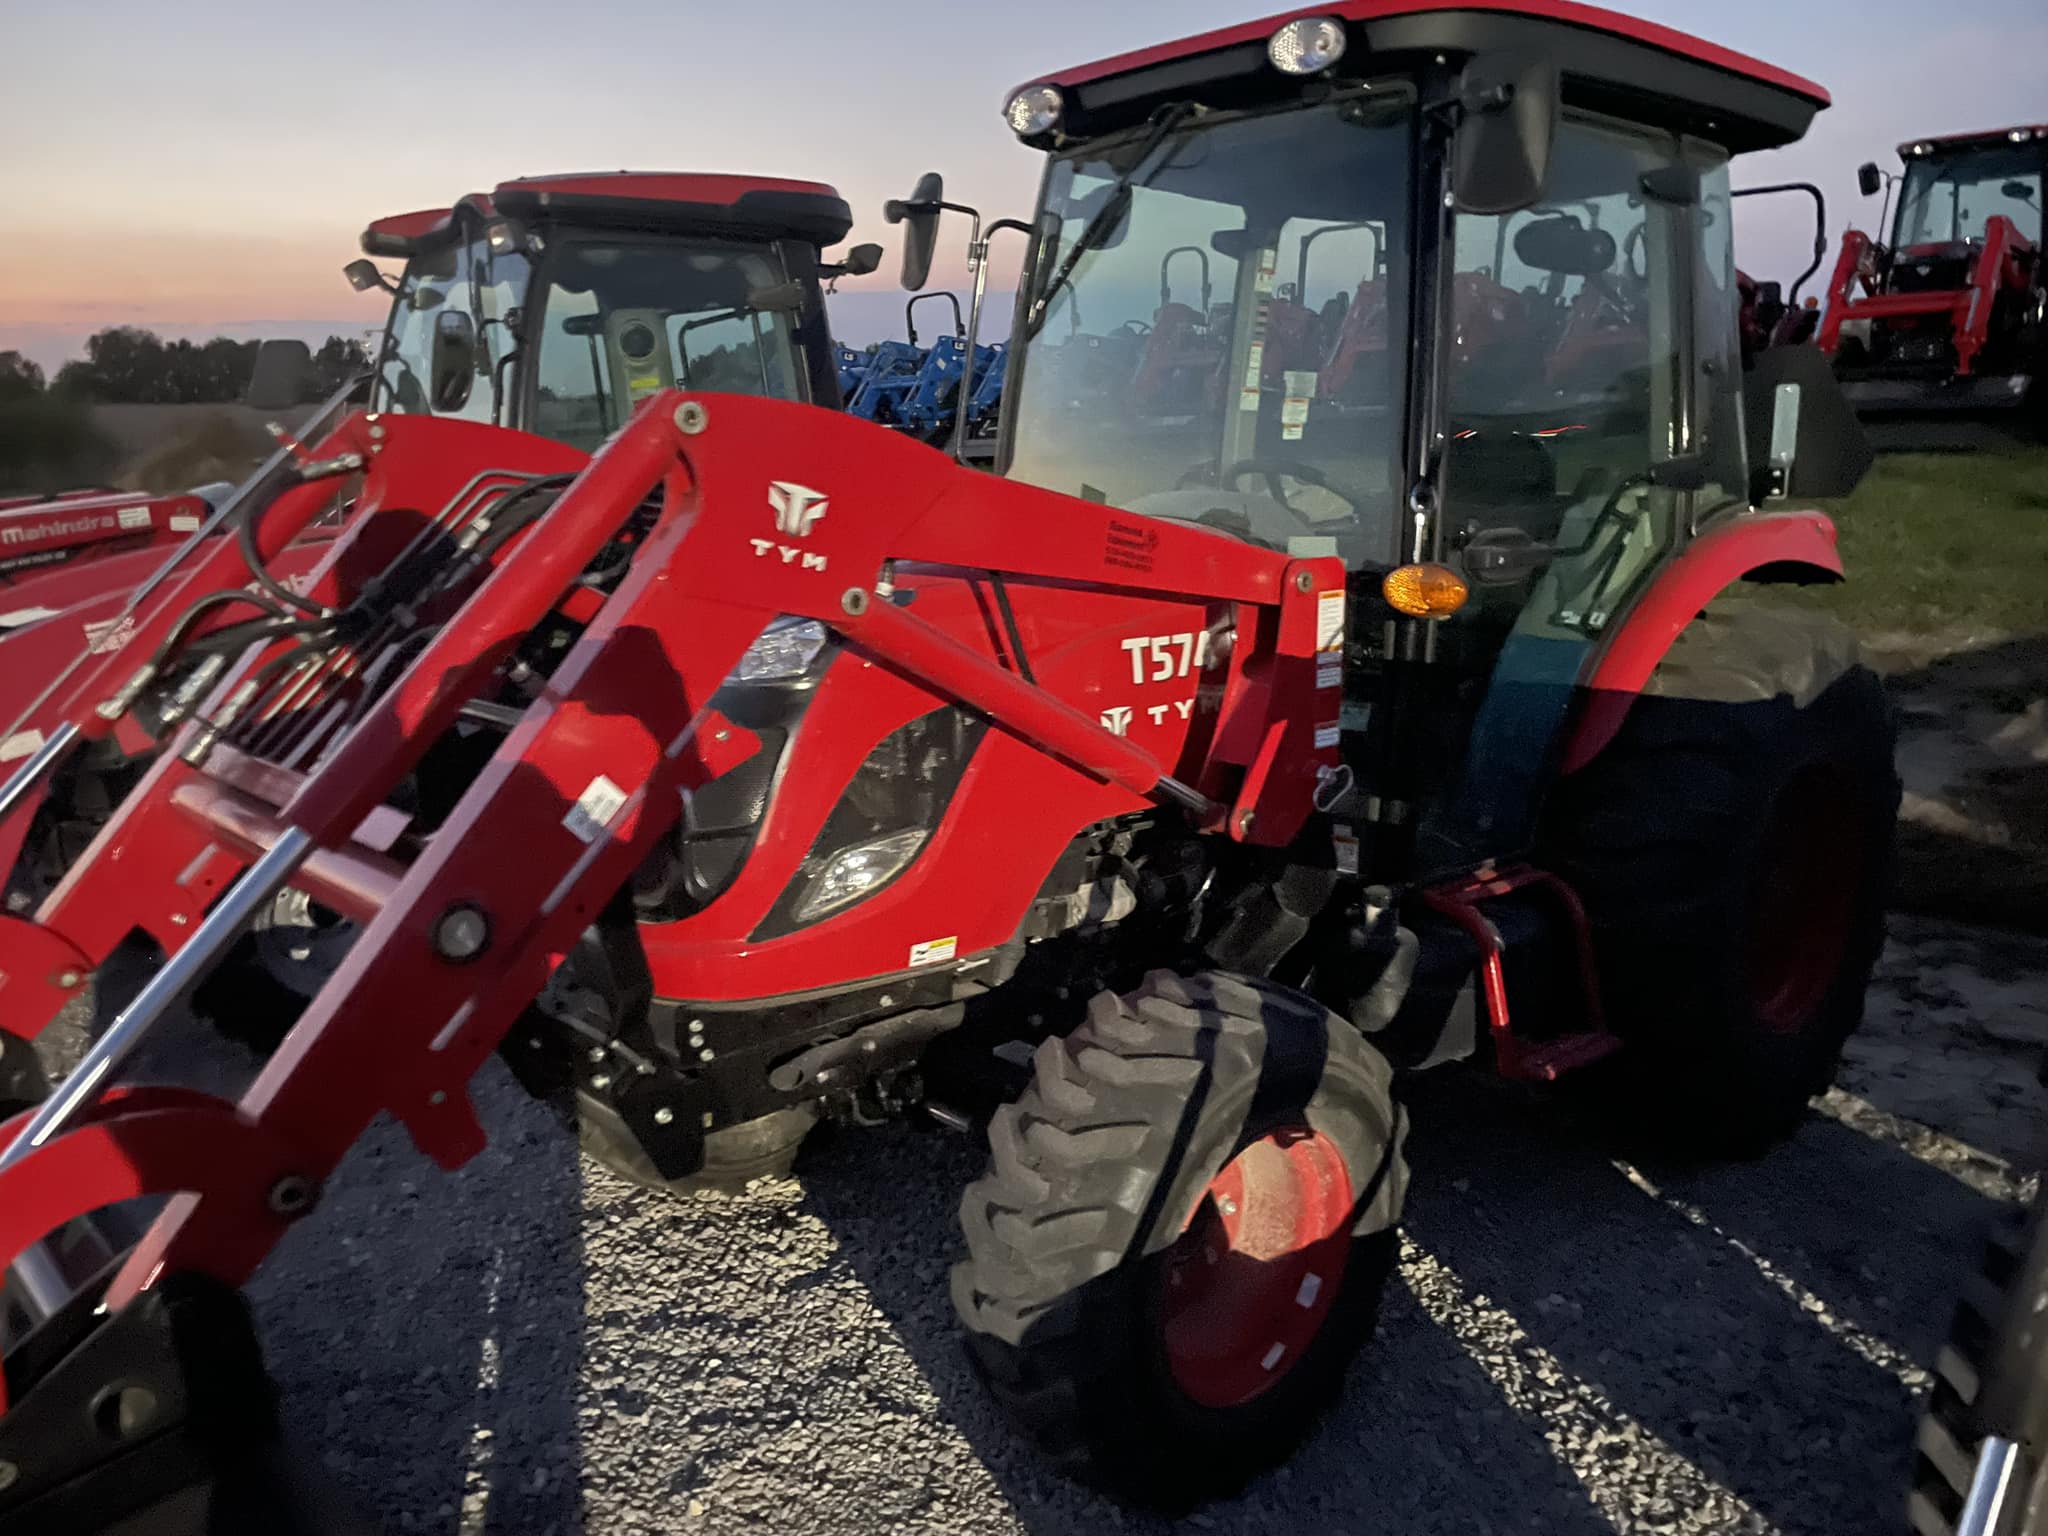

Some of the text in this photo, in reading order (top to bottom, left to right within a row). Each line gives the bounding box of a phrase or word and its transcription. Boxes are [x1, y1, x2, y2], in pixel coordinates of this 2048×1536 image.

[1, 515, 114, 544] Mahindra
[750, 538, 827, 571] TYM
[1147, 699, 1194, 725] TY
